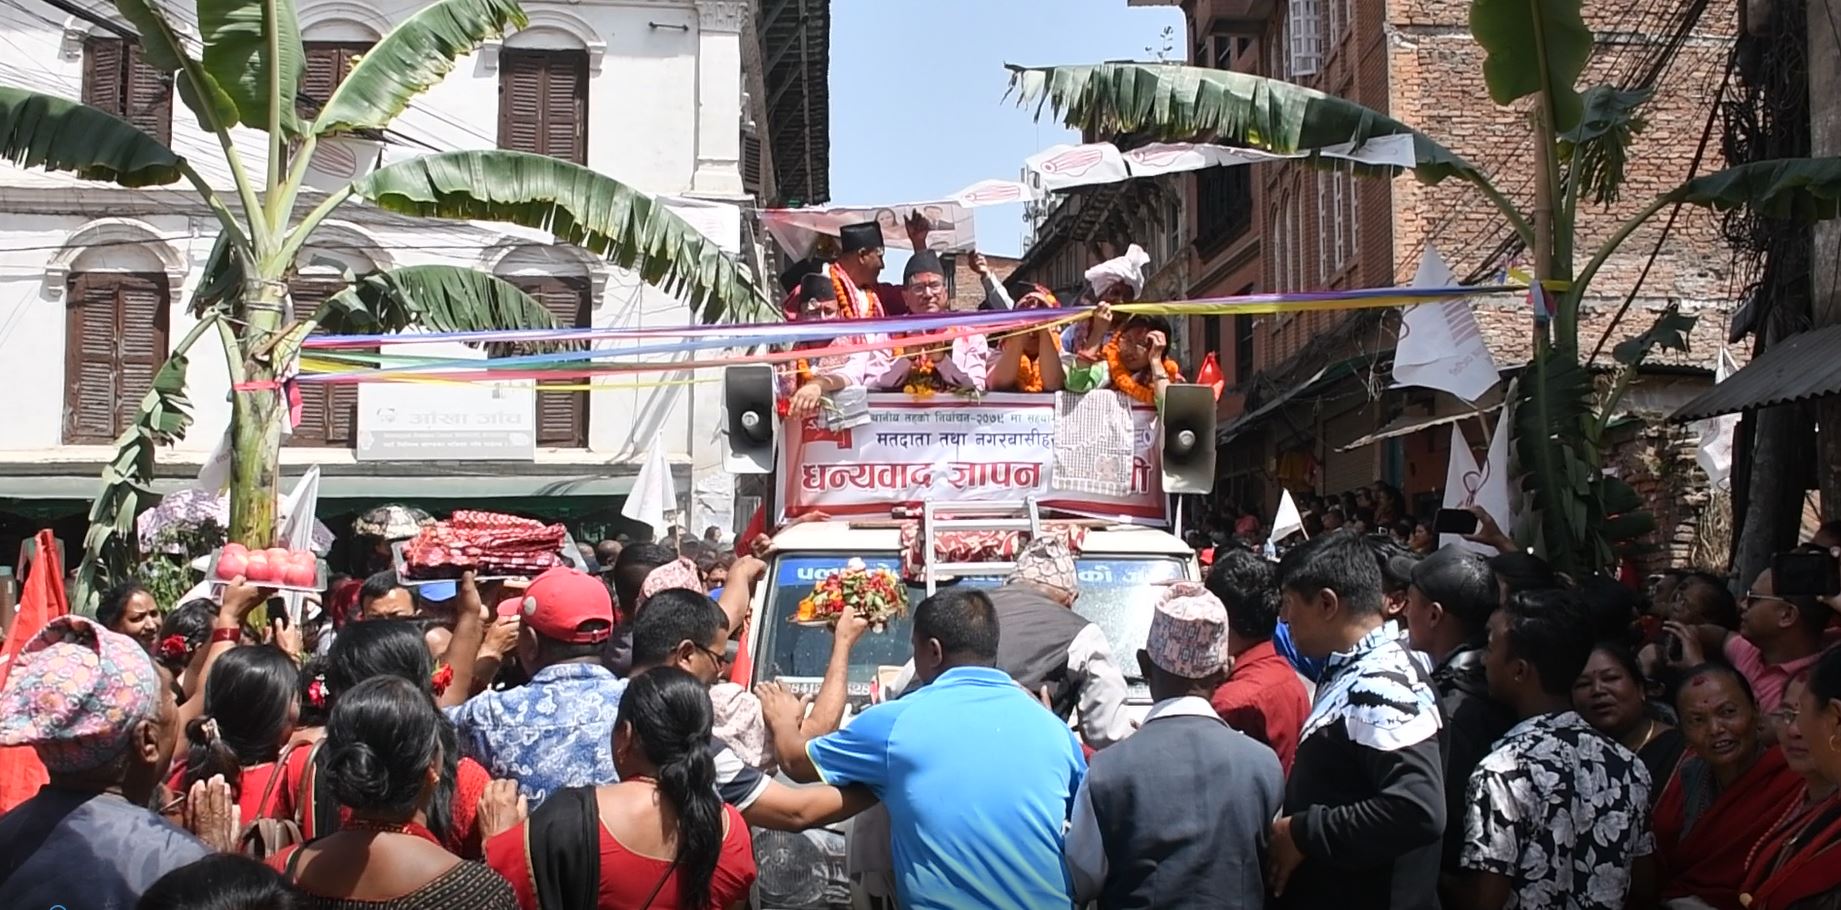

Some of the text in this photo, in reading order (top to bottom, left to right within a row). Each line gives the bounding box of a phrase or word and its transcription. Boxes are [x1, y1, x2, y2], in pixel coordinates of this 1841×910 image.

[876, 432, 932, 448] मतदाता
[939, 432, 968, 446] तथा
[802, 462, 1043, 490] धन्यवाद ज्ञापन
